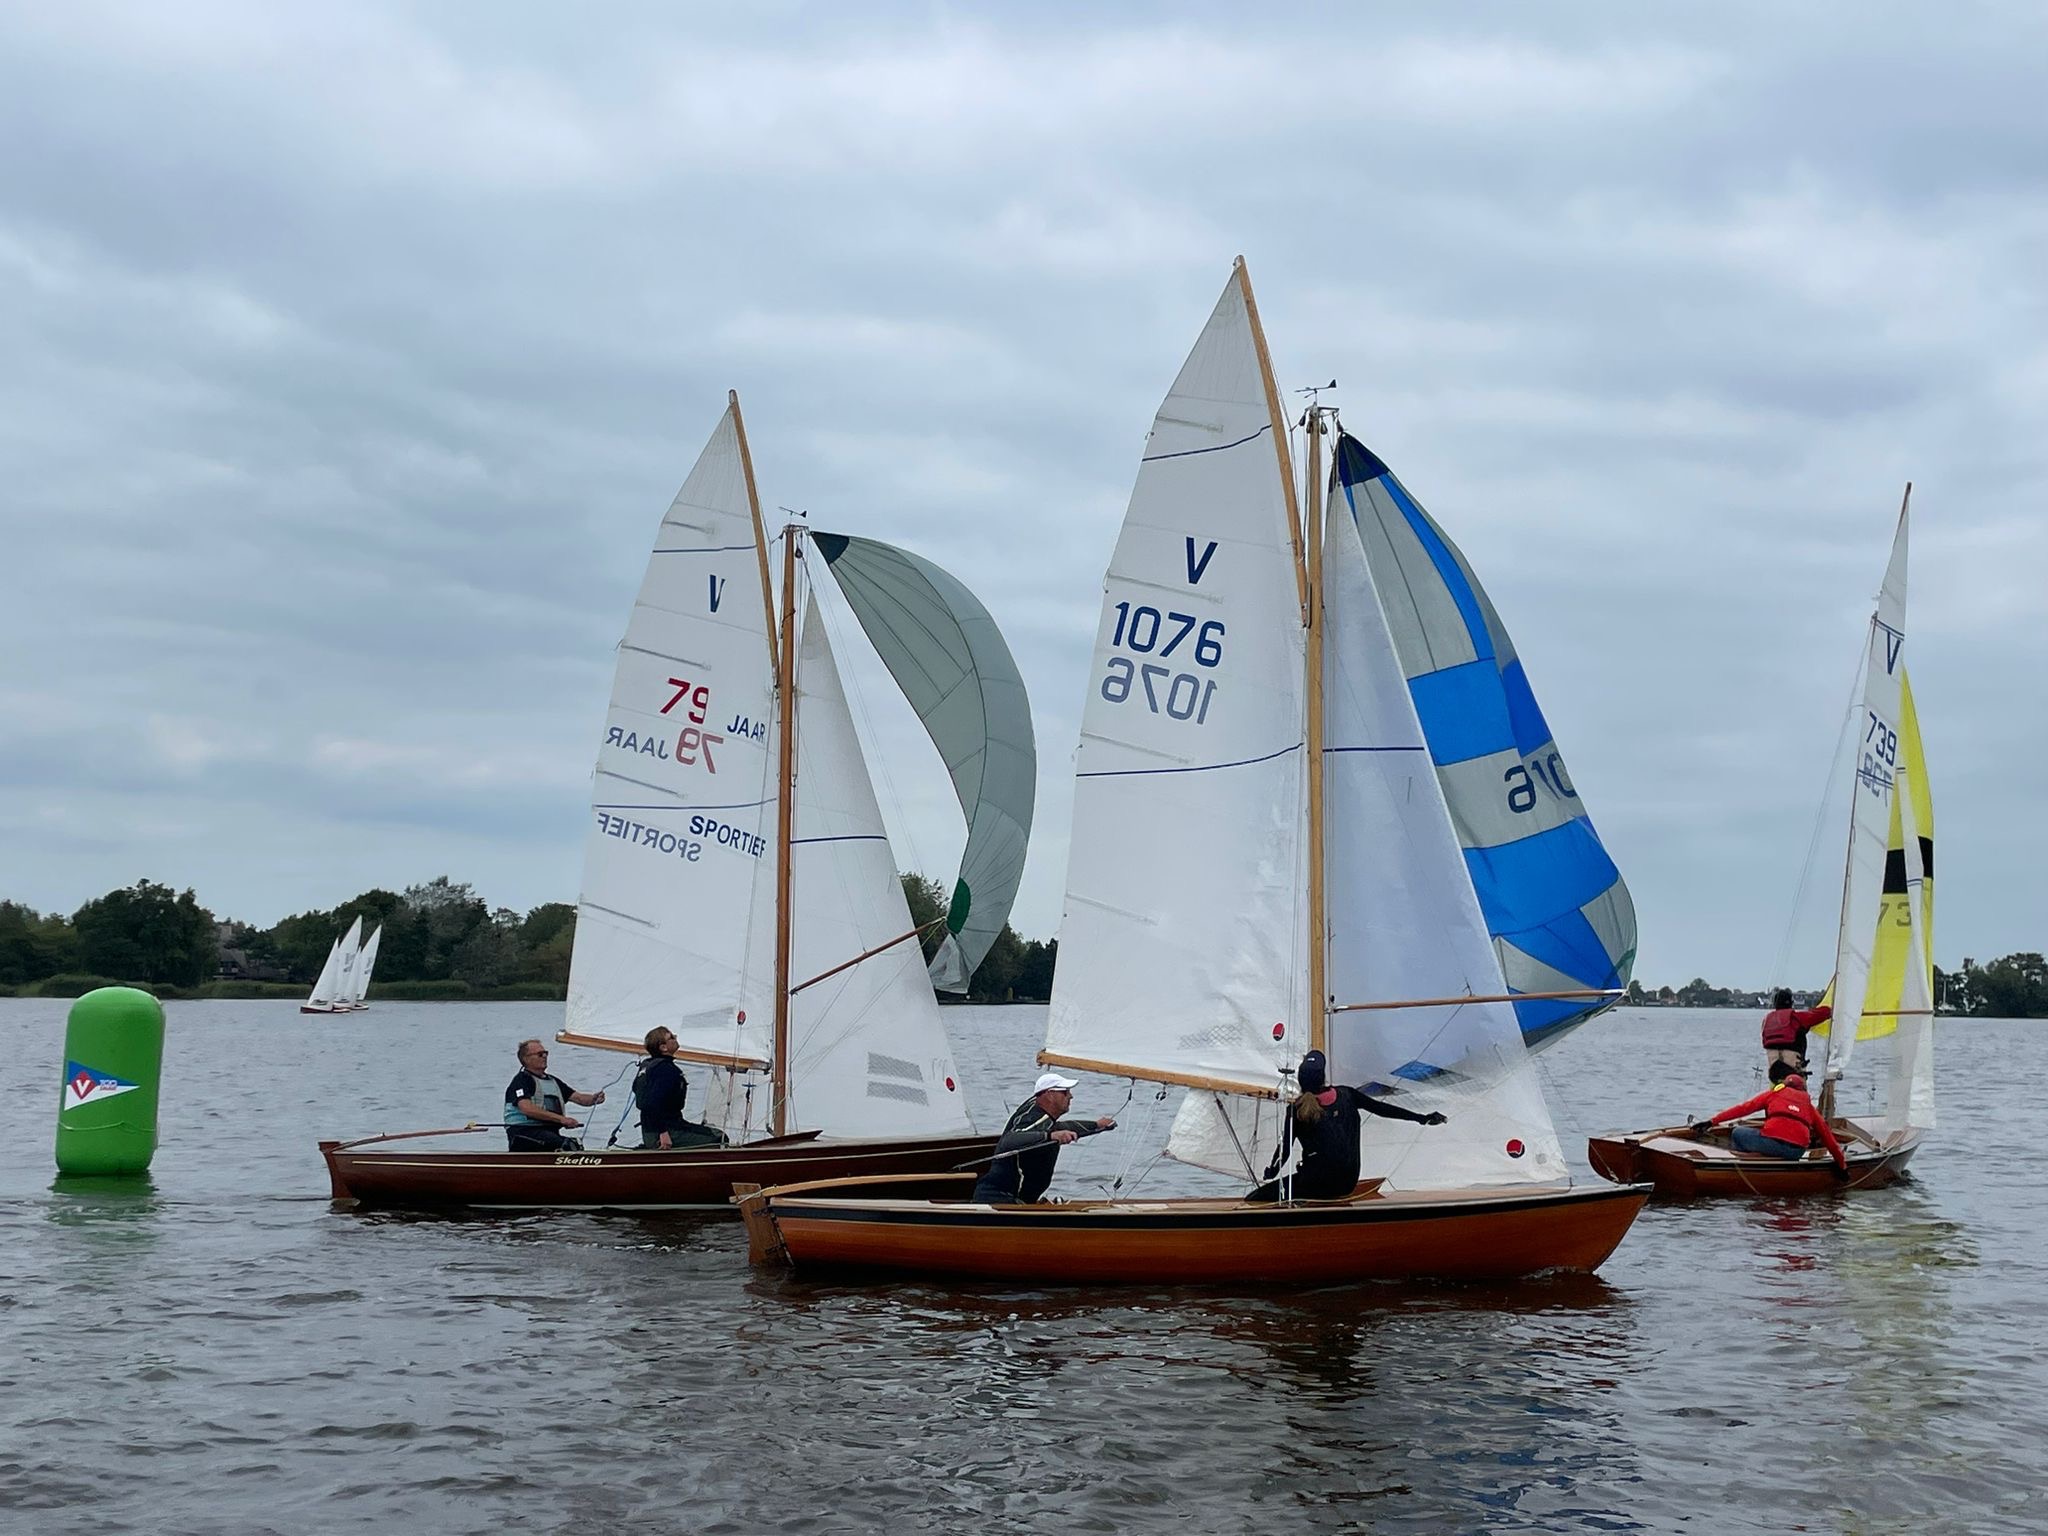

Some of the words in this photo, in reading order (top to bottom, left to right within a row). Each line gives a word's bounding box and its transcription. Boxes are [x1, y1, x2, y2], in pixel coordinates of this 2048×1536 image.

[1185, 536, 1219, 585] V
[708, 574, 726, 613] V
[1112, 601, 1226, 668] 1076
[1886, 631, 1902, 676] V
[659, 677, 711, 724] 79
[726, 714, 767, 744] JAAR
[1866, 710, 1898, 767] 739
[689, 815, 767, 859] SPORTIEF
[76, 1080, 91, 1096] V
